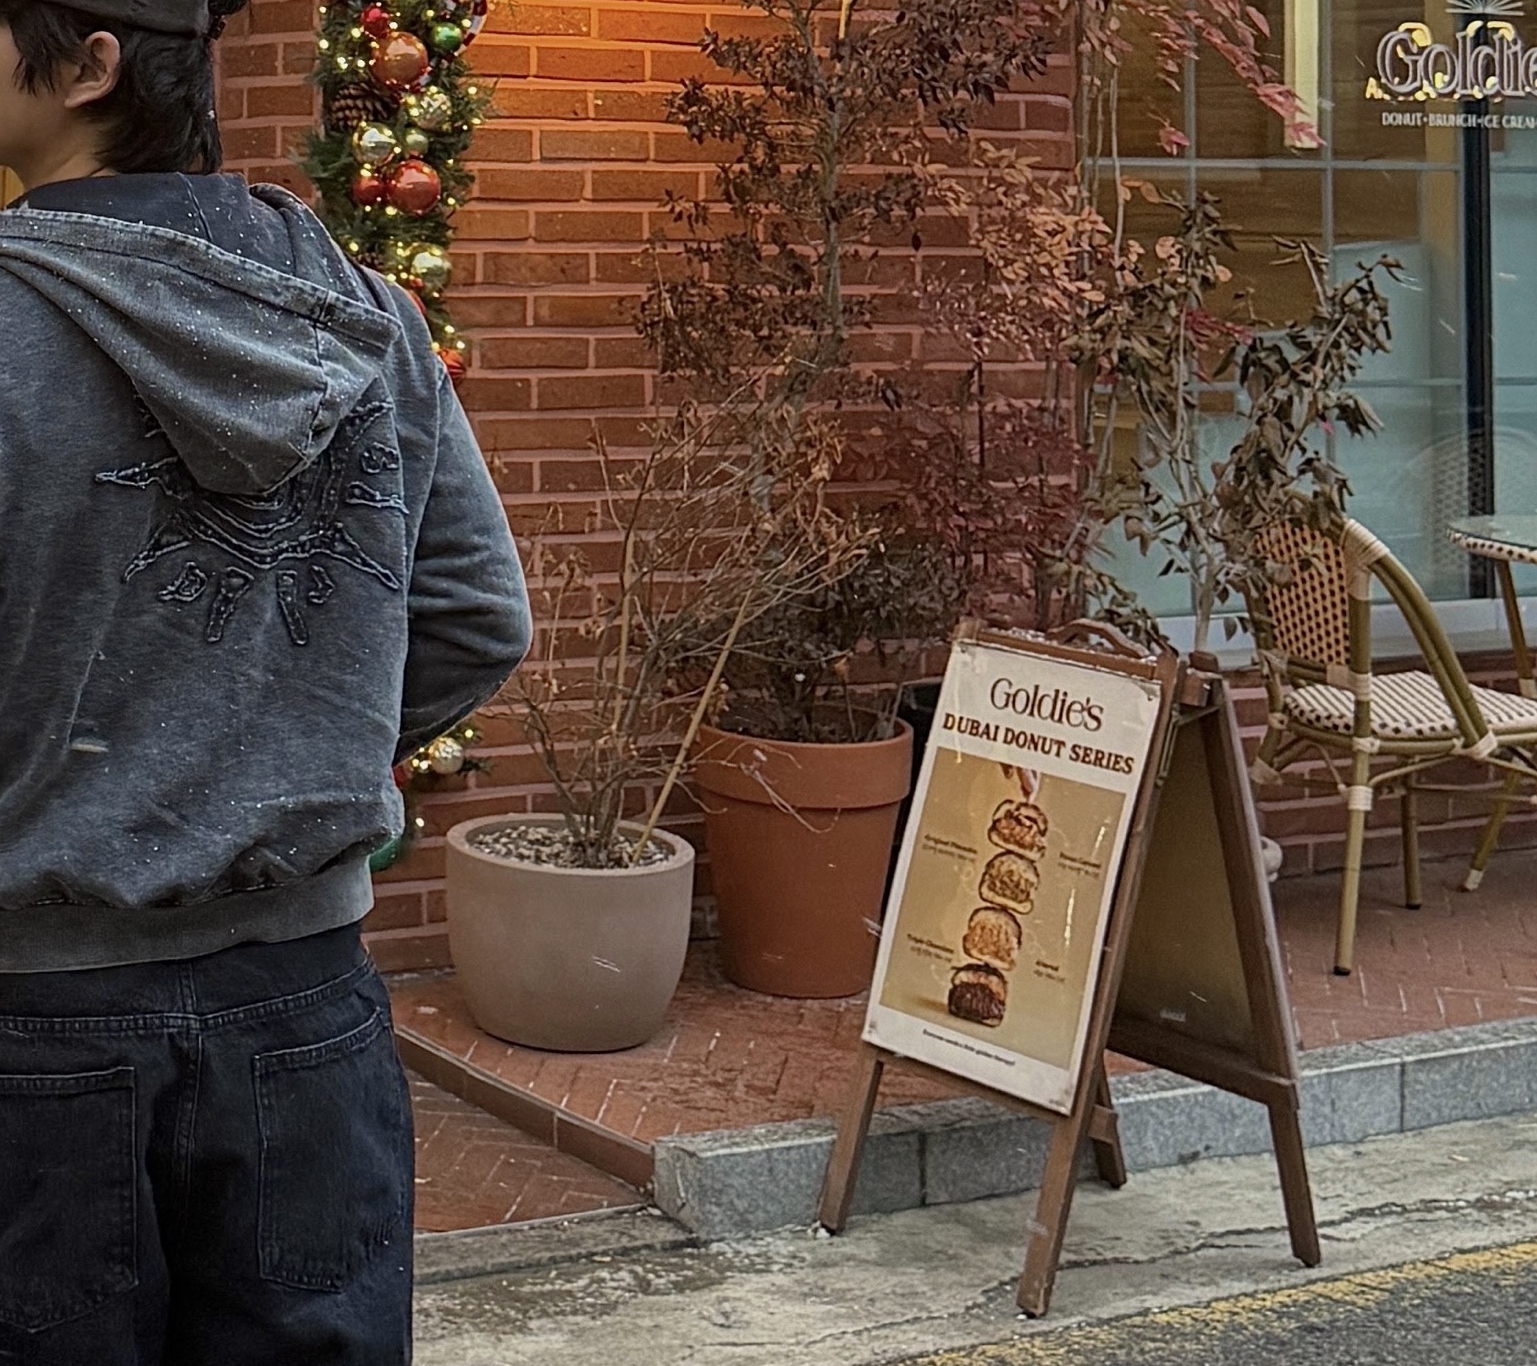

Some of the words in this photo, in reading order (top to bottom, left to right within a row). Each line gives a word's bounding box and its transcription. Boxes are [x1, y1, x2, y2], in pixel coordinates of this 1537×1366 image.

[1382, 112, 1422, 126] DONUT
[991, 678, 1104, 732] Goldie's
[942, 713, 1000, 742] DUBAI
[1003, 727, 1066, 758] DONUT
[1069, 744, 1135, 775] SERIES
